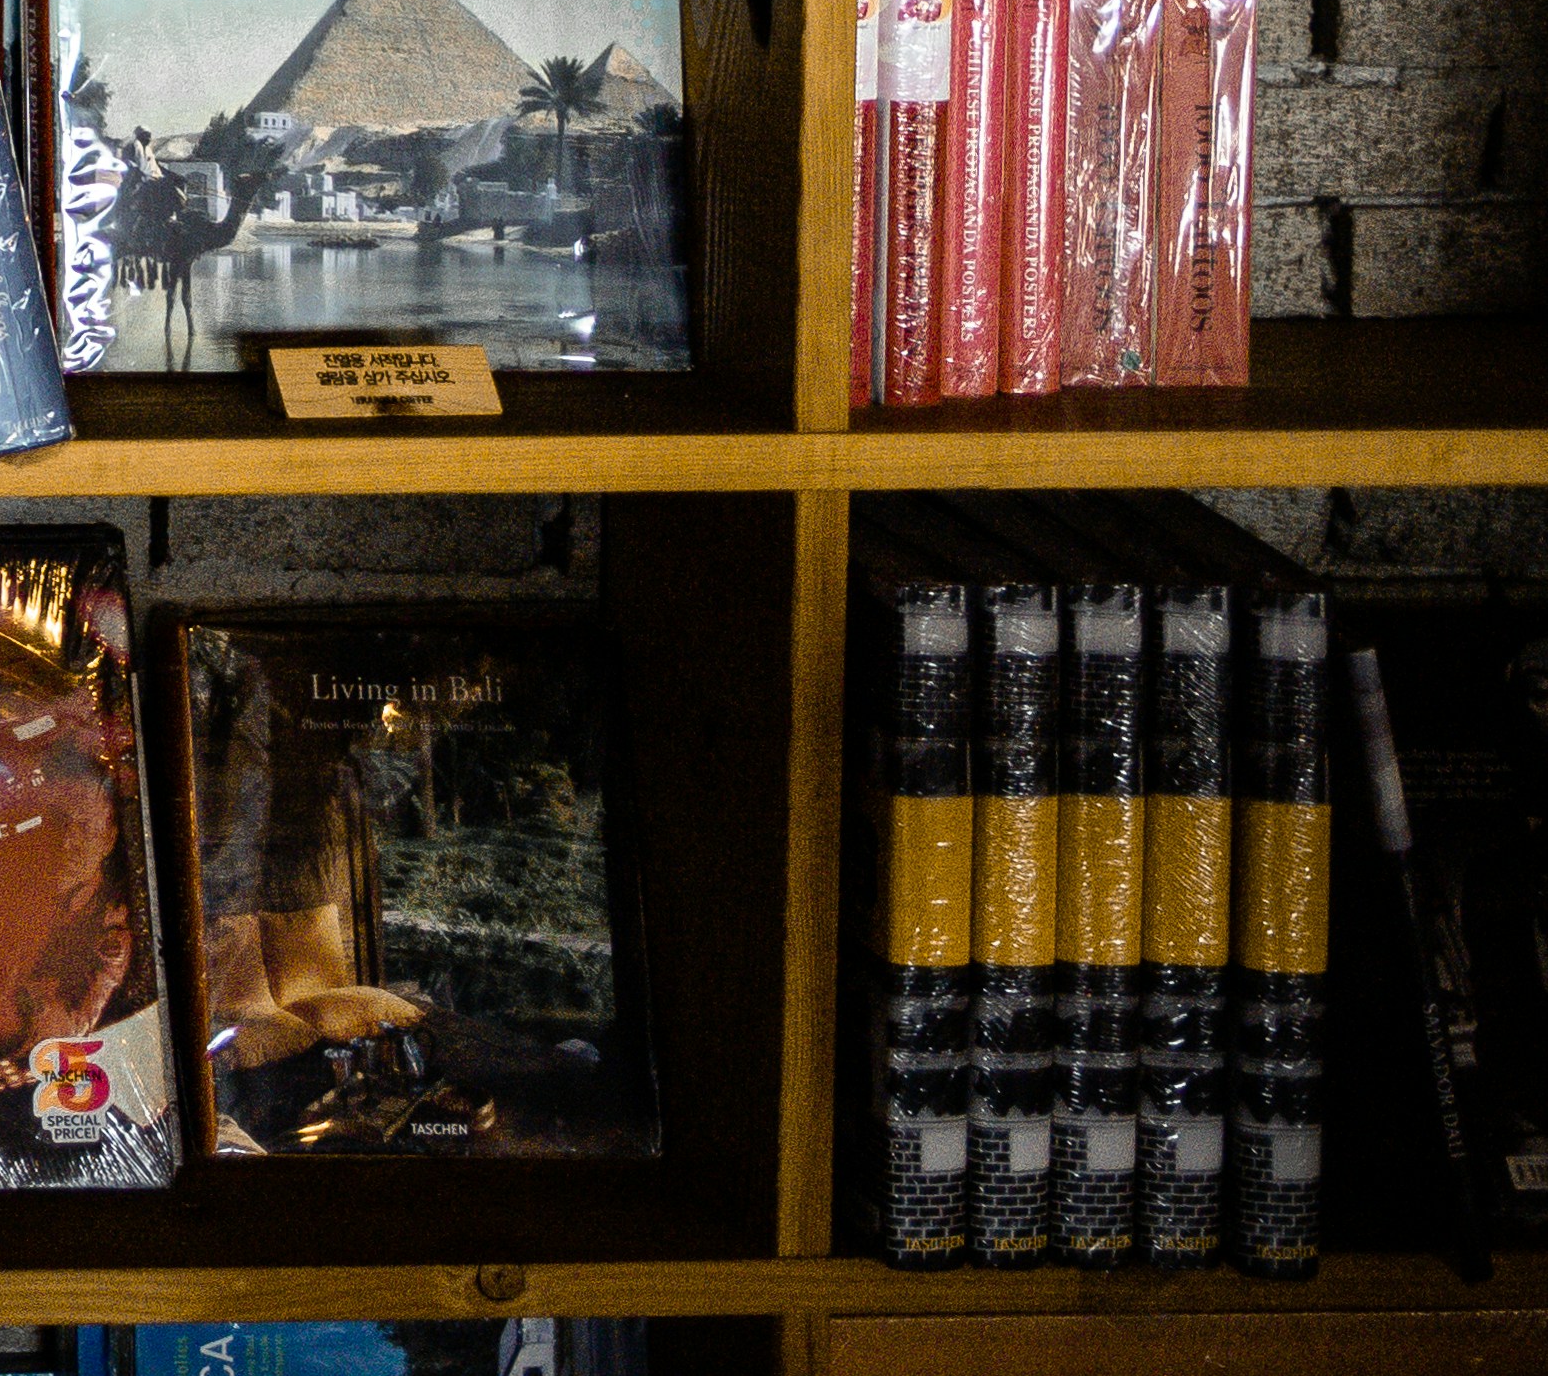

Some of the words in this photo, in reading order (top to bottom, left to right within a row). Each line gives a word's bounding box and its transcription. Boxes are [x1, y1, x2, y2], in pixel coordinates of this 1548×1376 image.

[311, 673, 399, 703] Living
[411, 676, 437, 702] in
[448, 675, 503, 703] Bali
